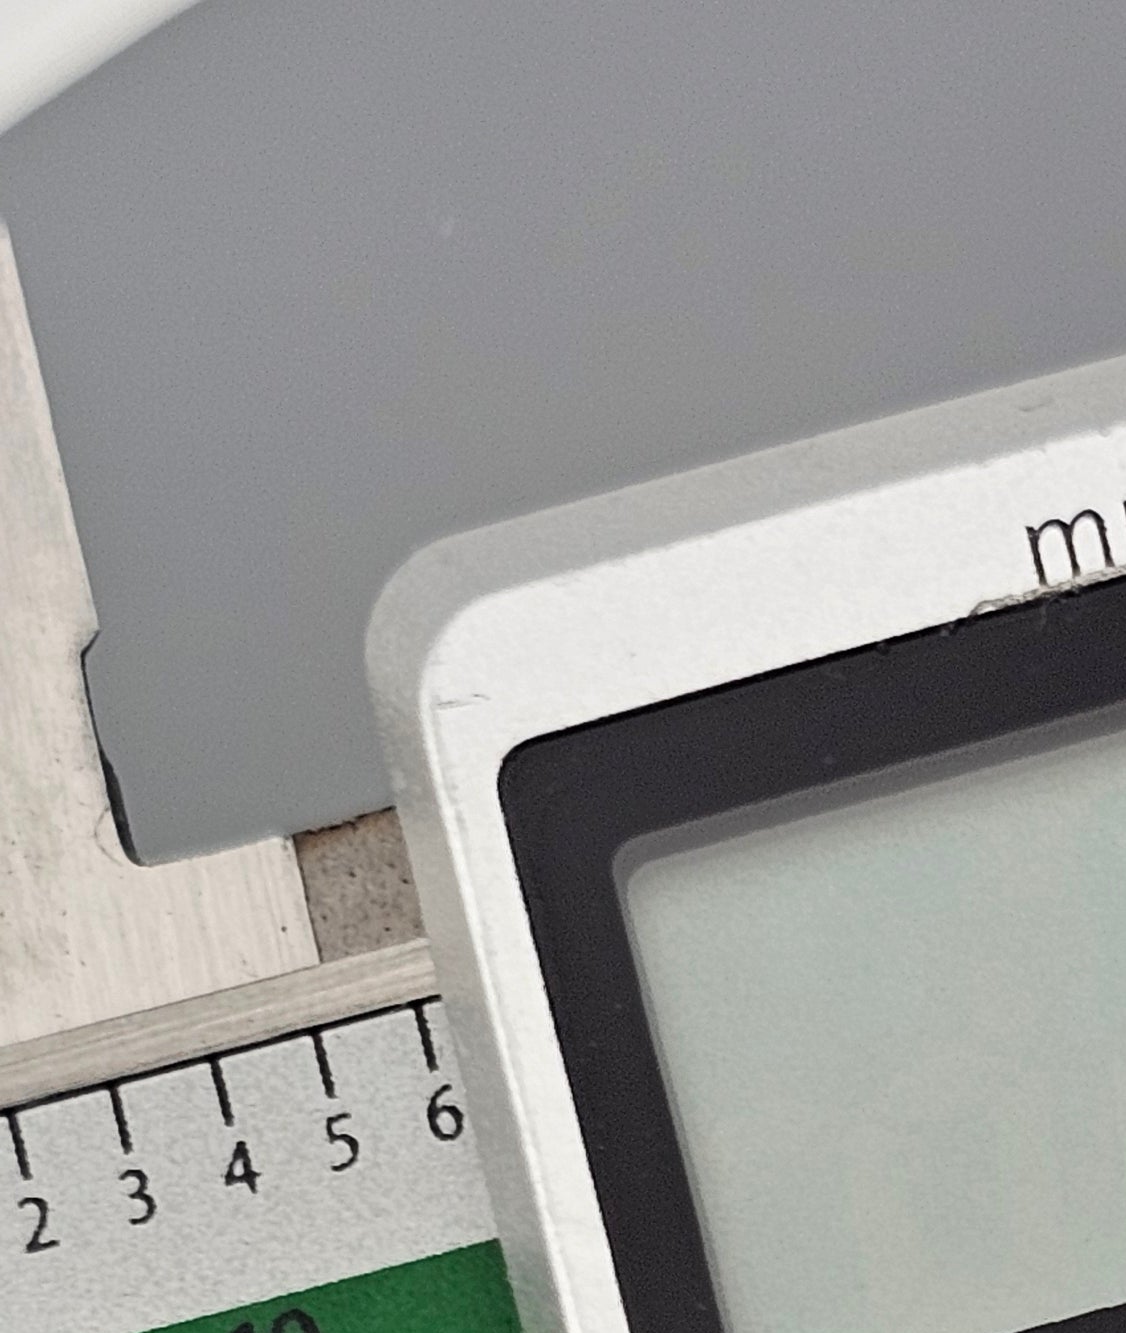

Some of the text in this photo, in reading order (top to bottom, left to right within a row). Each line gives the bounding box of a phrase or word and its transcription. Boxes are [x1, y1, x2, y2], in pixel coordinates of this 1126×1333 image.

[18, 1084, 465, 1253] 2 3 4 5 6
